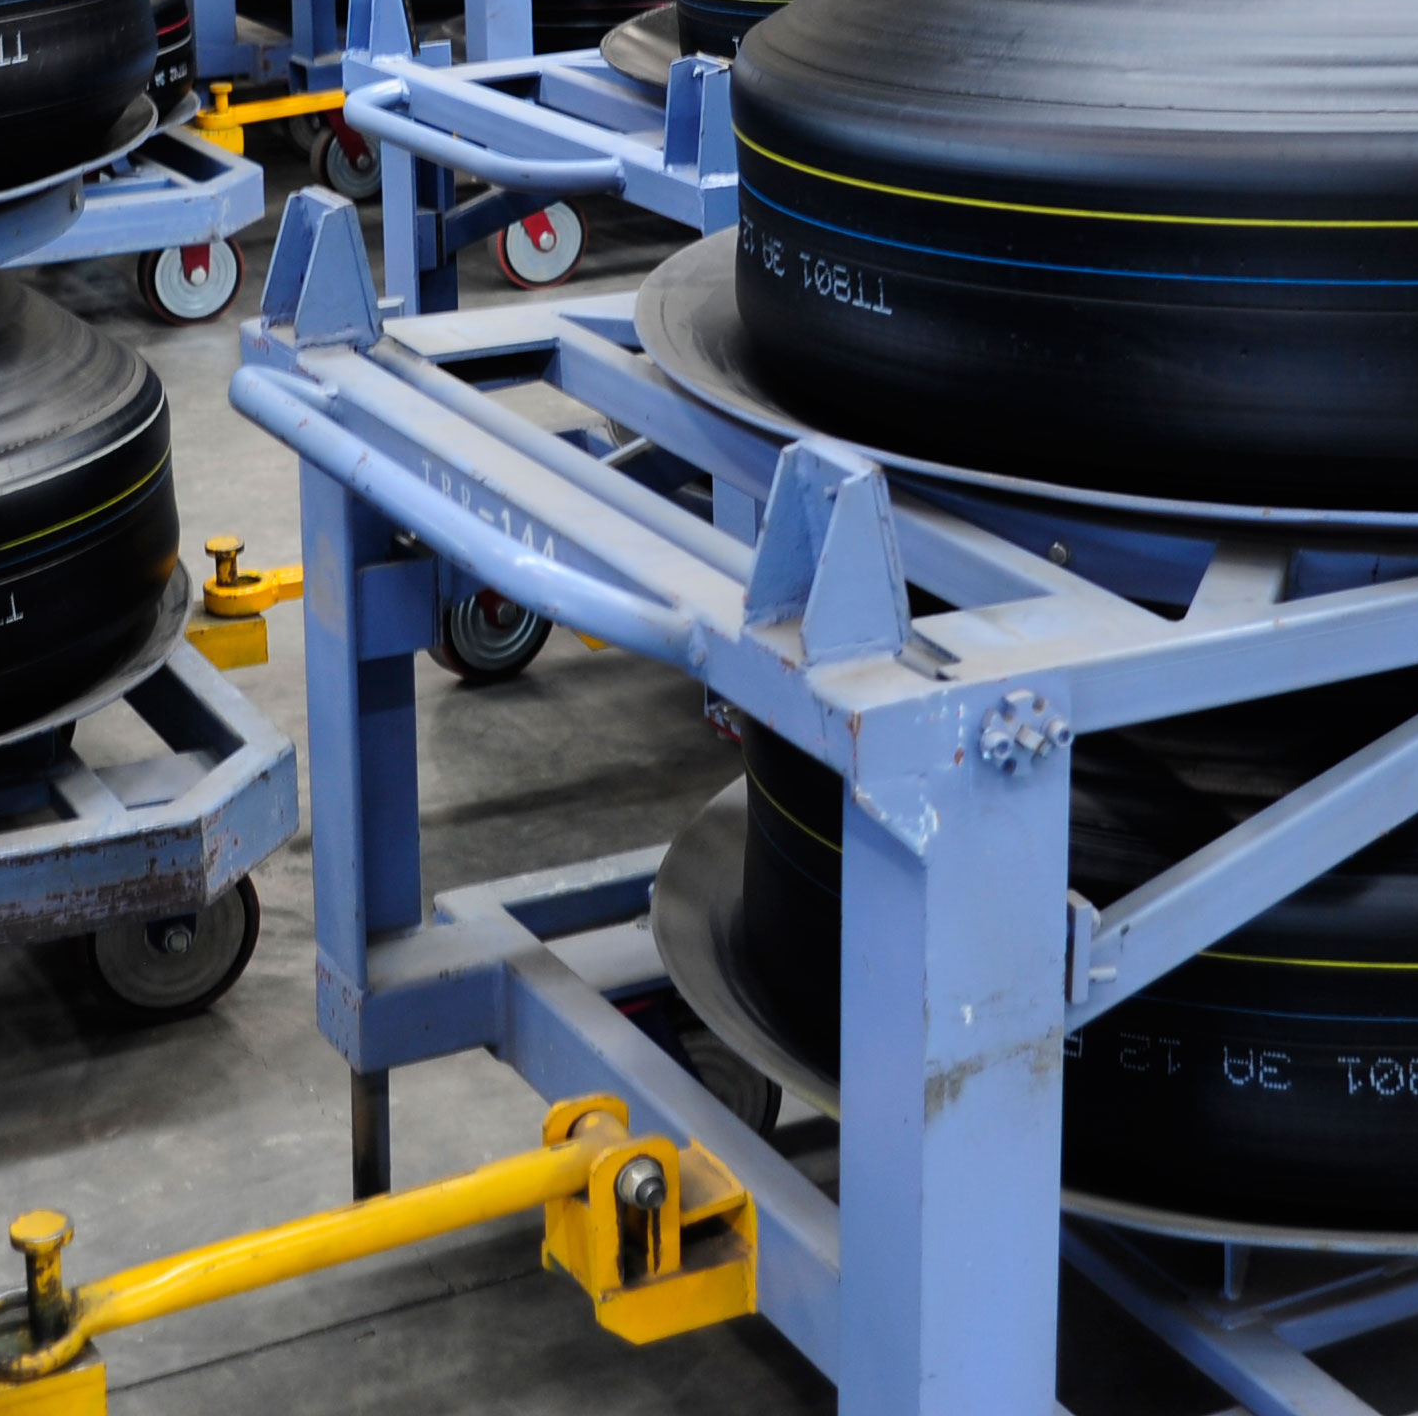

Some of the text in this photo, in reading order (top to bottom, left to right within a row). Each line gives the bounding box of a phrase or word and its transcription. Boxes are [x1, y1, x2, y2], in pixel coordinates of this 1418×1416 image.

[762, 231, 786, 278] 3A
[799, 251, 893, 316] TT801
[1120, 1030, 1181, 1075] 12
[1223, 1045, 1291, 1091] 3A
